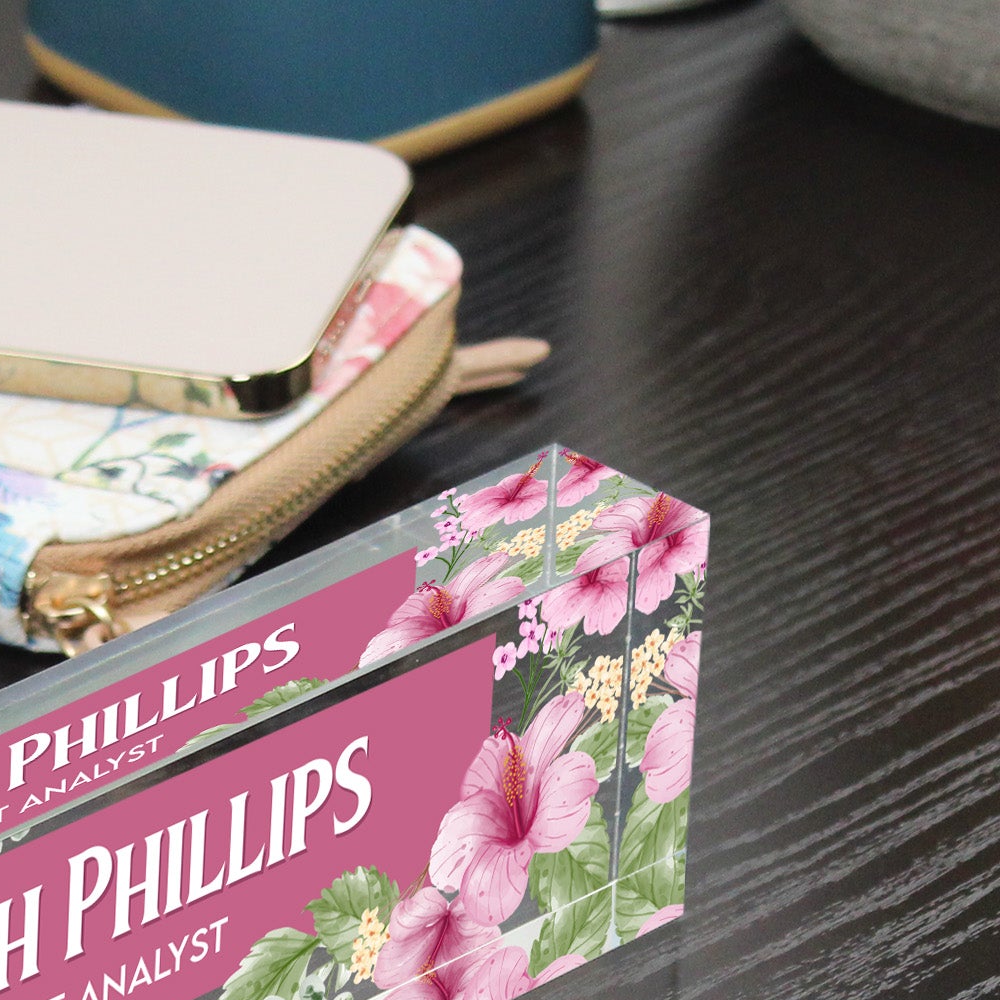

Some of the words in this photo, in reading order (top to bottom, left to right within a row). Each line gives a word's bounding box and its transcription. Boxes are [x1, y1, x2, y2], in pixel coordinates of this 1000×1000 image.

[8, 623, 300, 791] PHILLIPS
[20, 734, 164, 814] ANALYST
[65, 736, 372, 961] PHILLIPS
